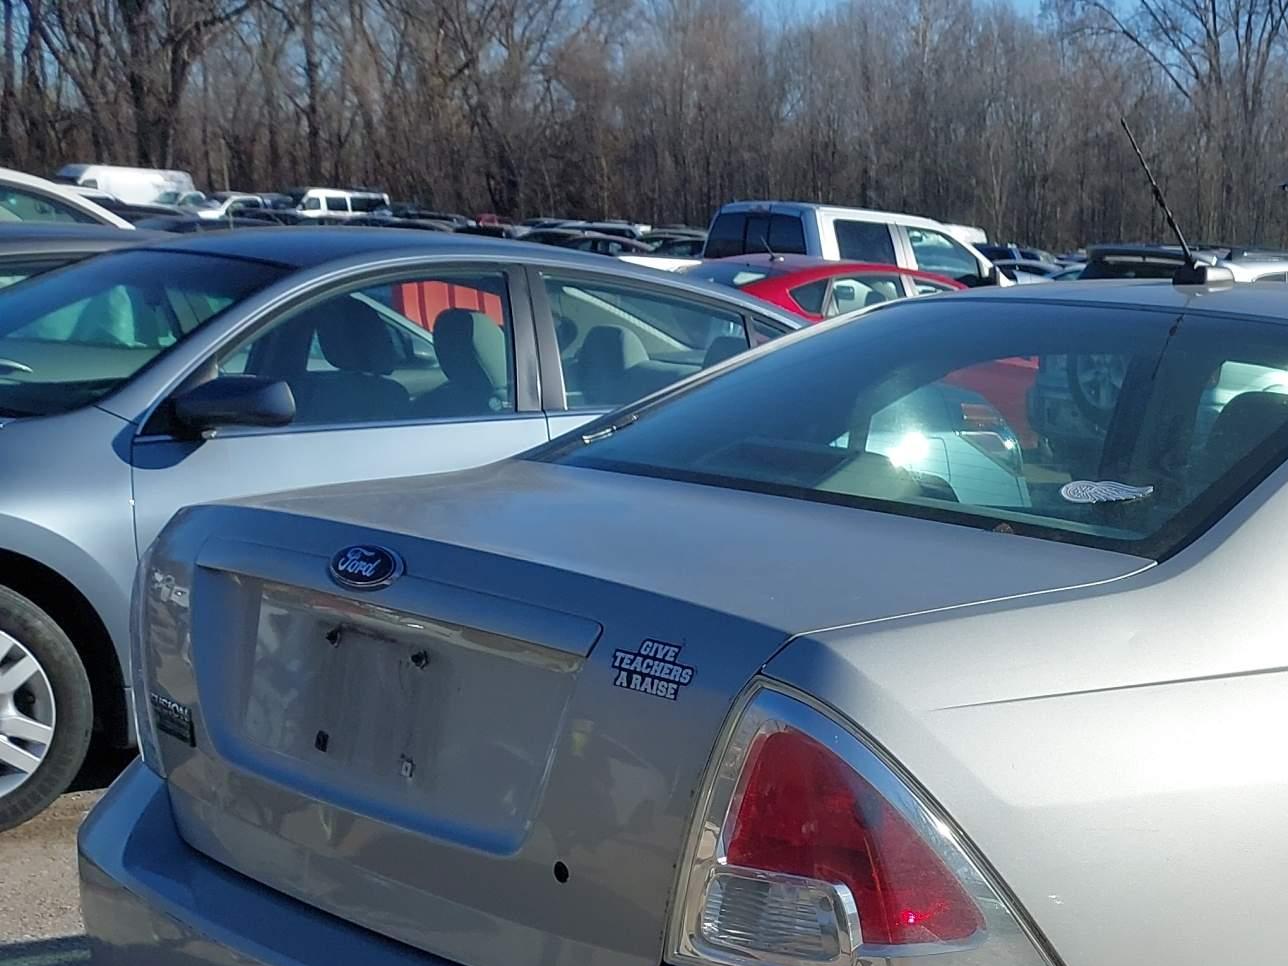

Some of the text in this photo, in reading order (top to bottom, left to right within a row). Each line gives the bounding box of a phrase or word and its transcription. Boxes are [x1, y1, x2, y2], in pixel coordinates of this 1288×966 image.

[338, 547, 381, 577] Ford
[640, 640, 679, 662] GIVE
[613, 651, 693, 684] TEACHERS
[615, 670, 678, 699] A RAISE
